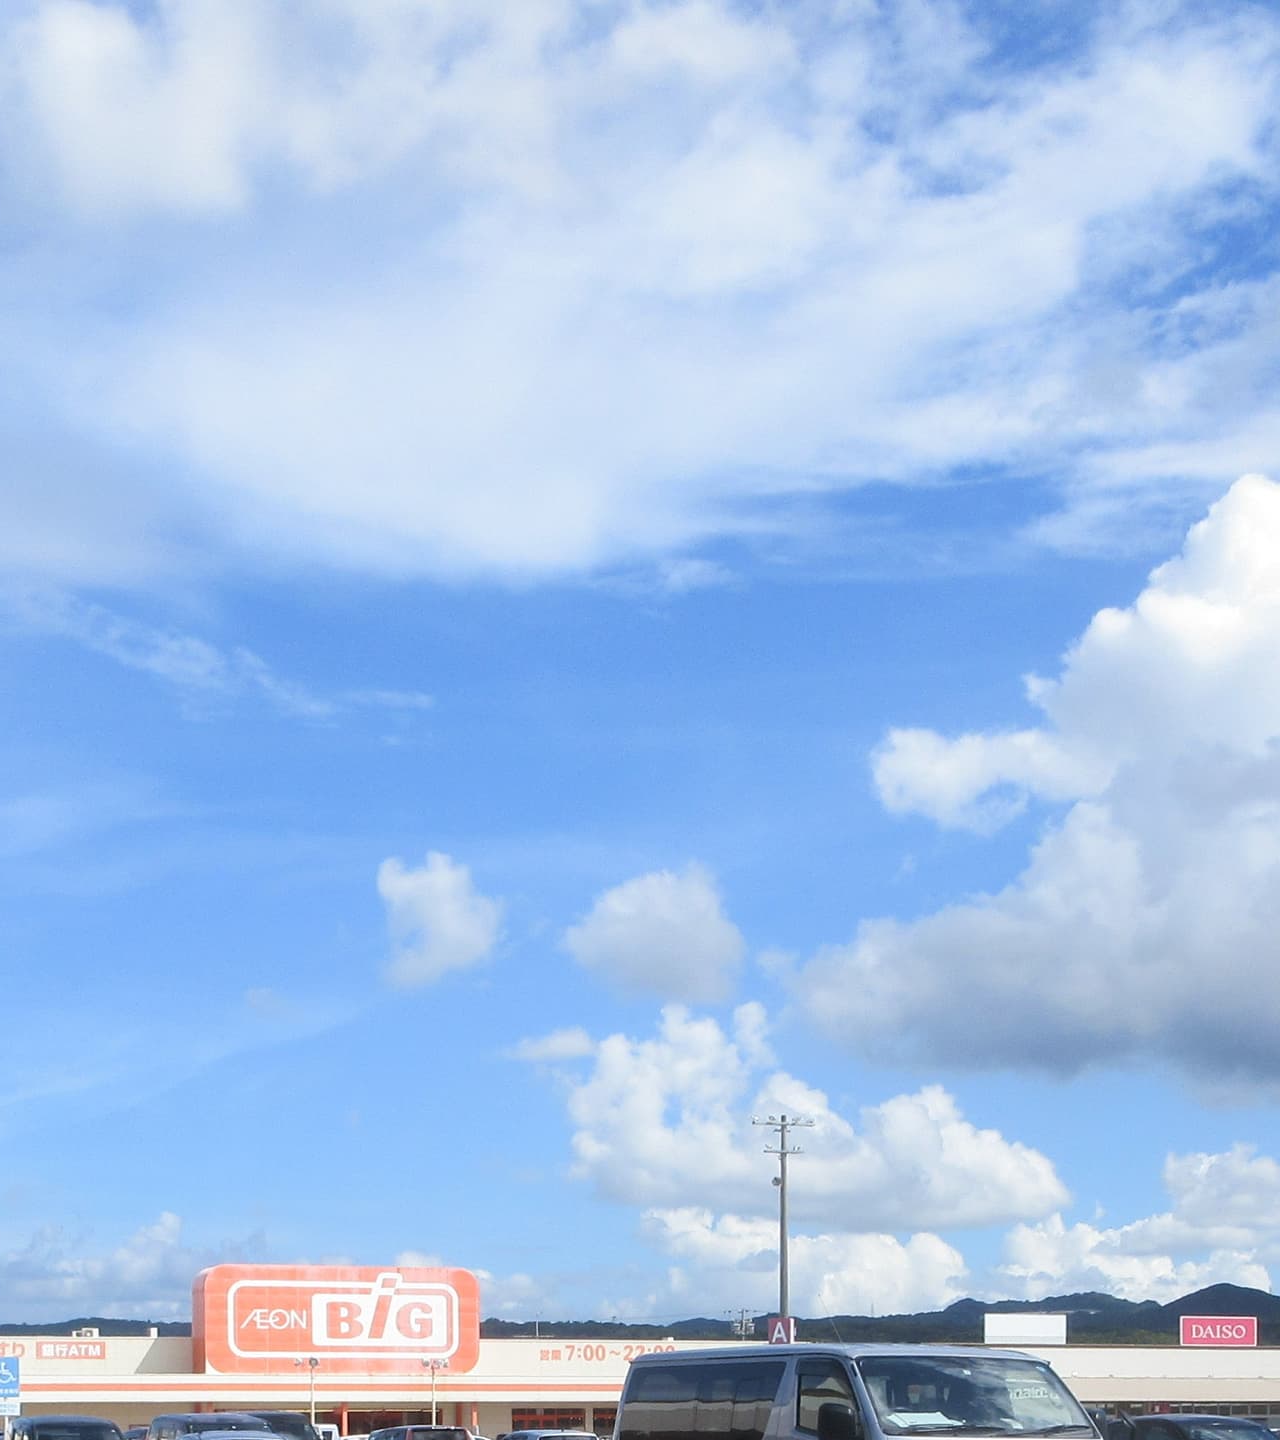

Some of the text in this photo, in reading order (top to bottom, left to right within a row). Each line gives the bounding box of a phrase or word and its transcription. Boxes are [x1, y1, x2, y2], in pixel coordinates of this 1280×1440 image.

[772, 1322, 788, 1343] A
[1191, 1324, 1247, 1339] DAISO
[41, 1343, 101, 1357] 銀行ATM
